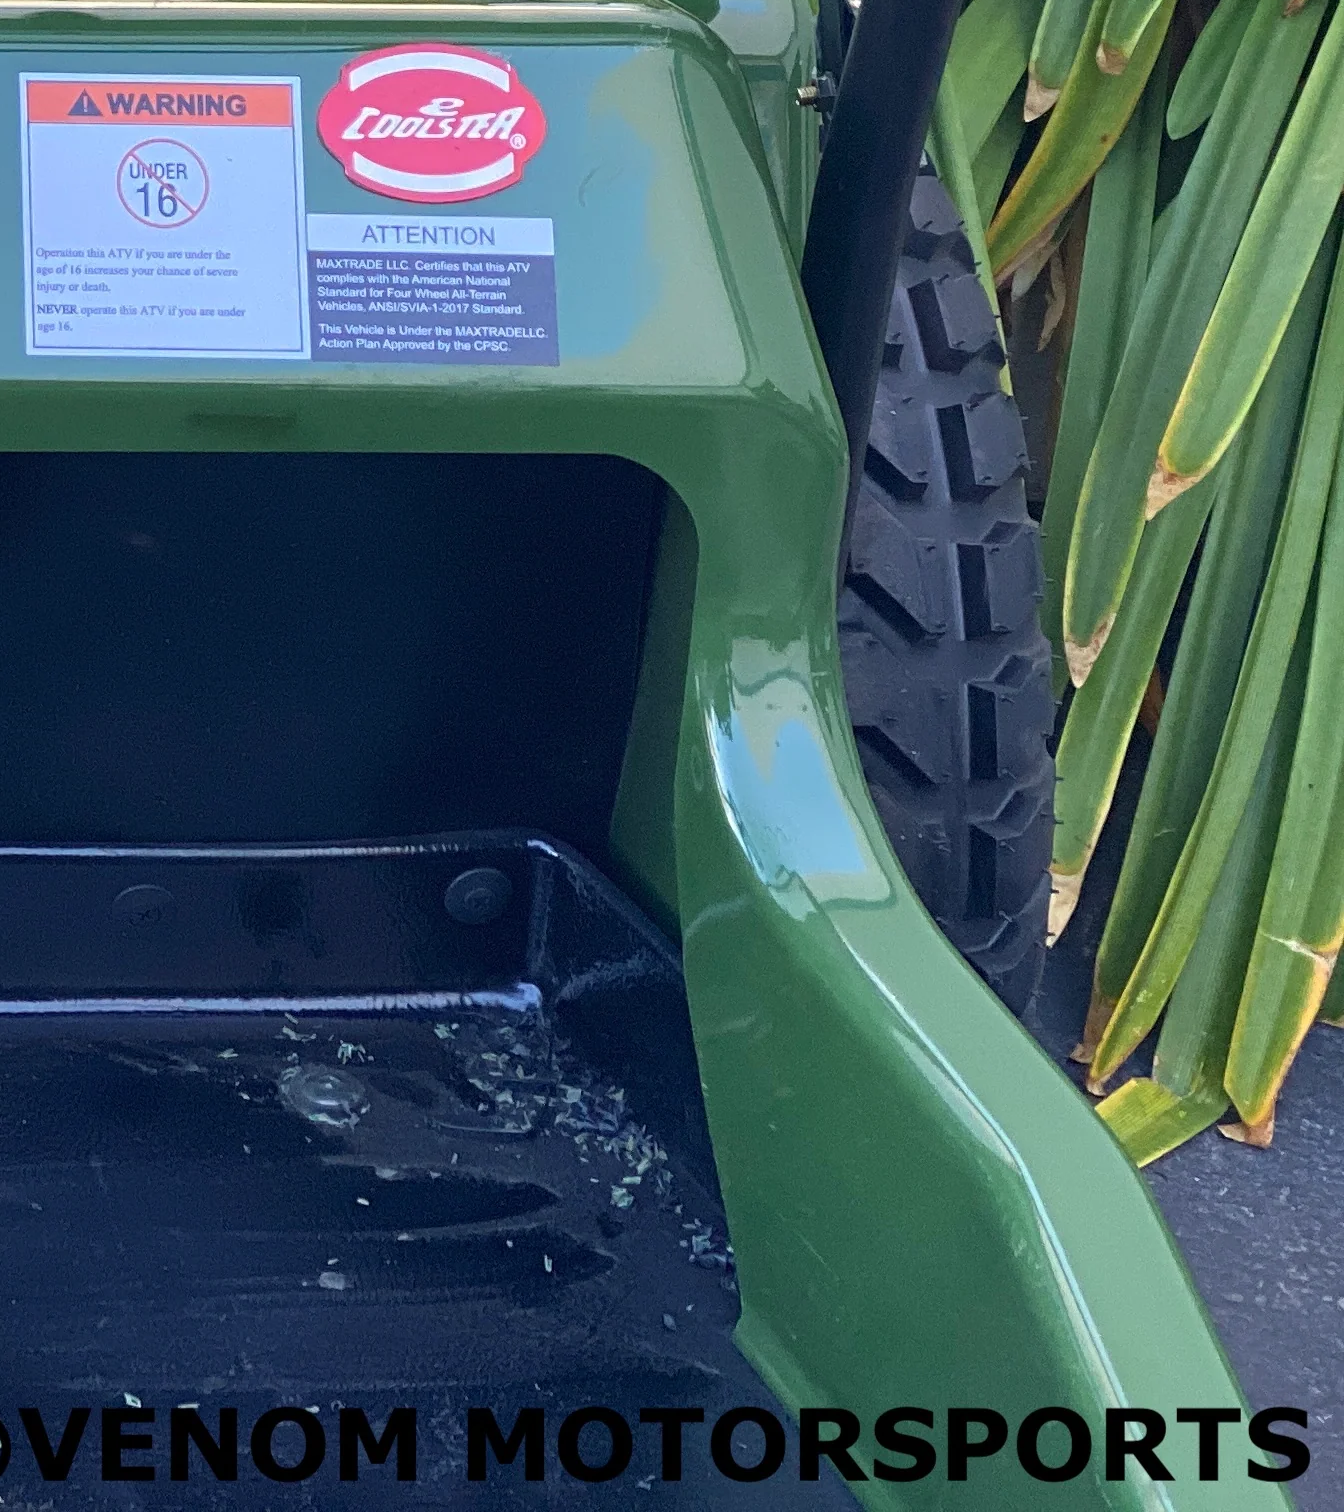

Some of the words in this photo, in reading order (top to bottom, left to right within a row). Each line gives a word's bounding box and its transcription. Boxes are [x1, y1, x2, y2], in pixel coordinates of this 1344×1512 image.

[106, 92, 248, 117] WARNING
[129, 162, 189, 180] UNDER
[136, 181, 178, 218] 16
[361, 224, 496, 246] ATTENTION
[87, 248, 106, 258] this
[108, 248, 133, 259] ATV
[135, 248, 145, 259] if
[146, 251, 165, 261] you
[167, 251, 183, 260] are
[185, 249, 213, 260] under
[215, 249, 231, 260] the
[36, 266, 54, 277] age
[56, 263, 68, 275] of
[70, 264, 82, 275] 16
[84, 265, 129, 276] increases
[132, 267, 154, 278] your
[156, 265, 192, 276] chance
[193, 266, 206, 276] of
[206, 267, 239, 277] severe
[316, 258, 384, 270] MAXTRADE
[414, 260, 460, 272] Certifies
[462, 261, 484, 272] that
[485, 261, 506, 273] this
[506, 262, 531, 274] ATV
[36, 281, 66, 293] injury
[68, 283, 80, 291] or
[81, 280, 111, 292] death.
[316, 273, 365, 285] complies
[367, 273, 390, 284] with
[392, 274, 410, 285] the
[412, 274, 463, 285] American
[465, 275, 511, 286] National
[317, 286, 367, 297] Standard
[369, 287, 385, 298] for
[386, 287, 412, 299] Four
[414, 288, 450, 300] Wheel
[452, 289, 507, 300] All-Terrain
[36, 303, 78, 315] NEVER
[80, 306, 117, 318] operate
[119, 304, 138, 316] this
[140, 305, 166, 316] ATV
[167, 306, 178, 316] if
[178, 307, 197, 318] you
[199, 308, 216, 317] are
[217, 305, 247, 317] under
[368, 301, 470, 314] ANSI/SVIA-1-2017
[472, 303, 526, 316] Standard.
[37, 322, 56, 334] age
[58, 320, 74, 332] 16.
[318, 323, 342, 335] This
[344, 324, 385, 336] Vehicle
[386, 324, 397, 336] is
[398, 325, 433, 337] Under
[434, 325, 453, 337] the
[318, 337, 353, 349] Action
[355, 338, 381, 350] Plan
[382, 339, 435, 352] Approved
[437, 340, 451, 353] by
[453, 340, 472, 352] the
[473, 341, 512, 353] CPSC.
